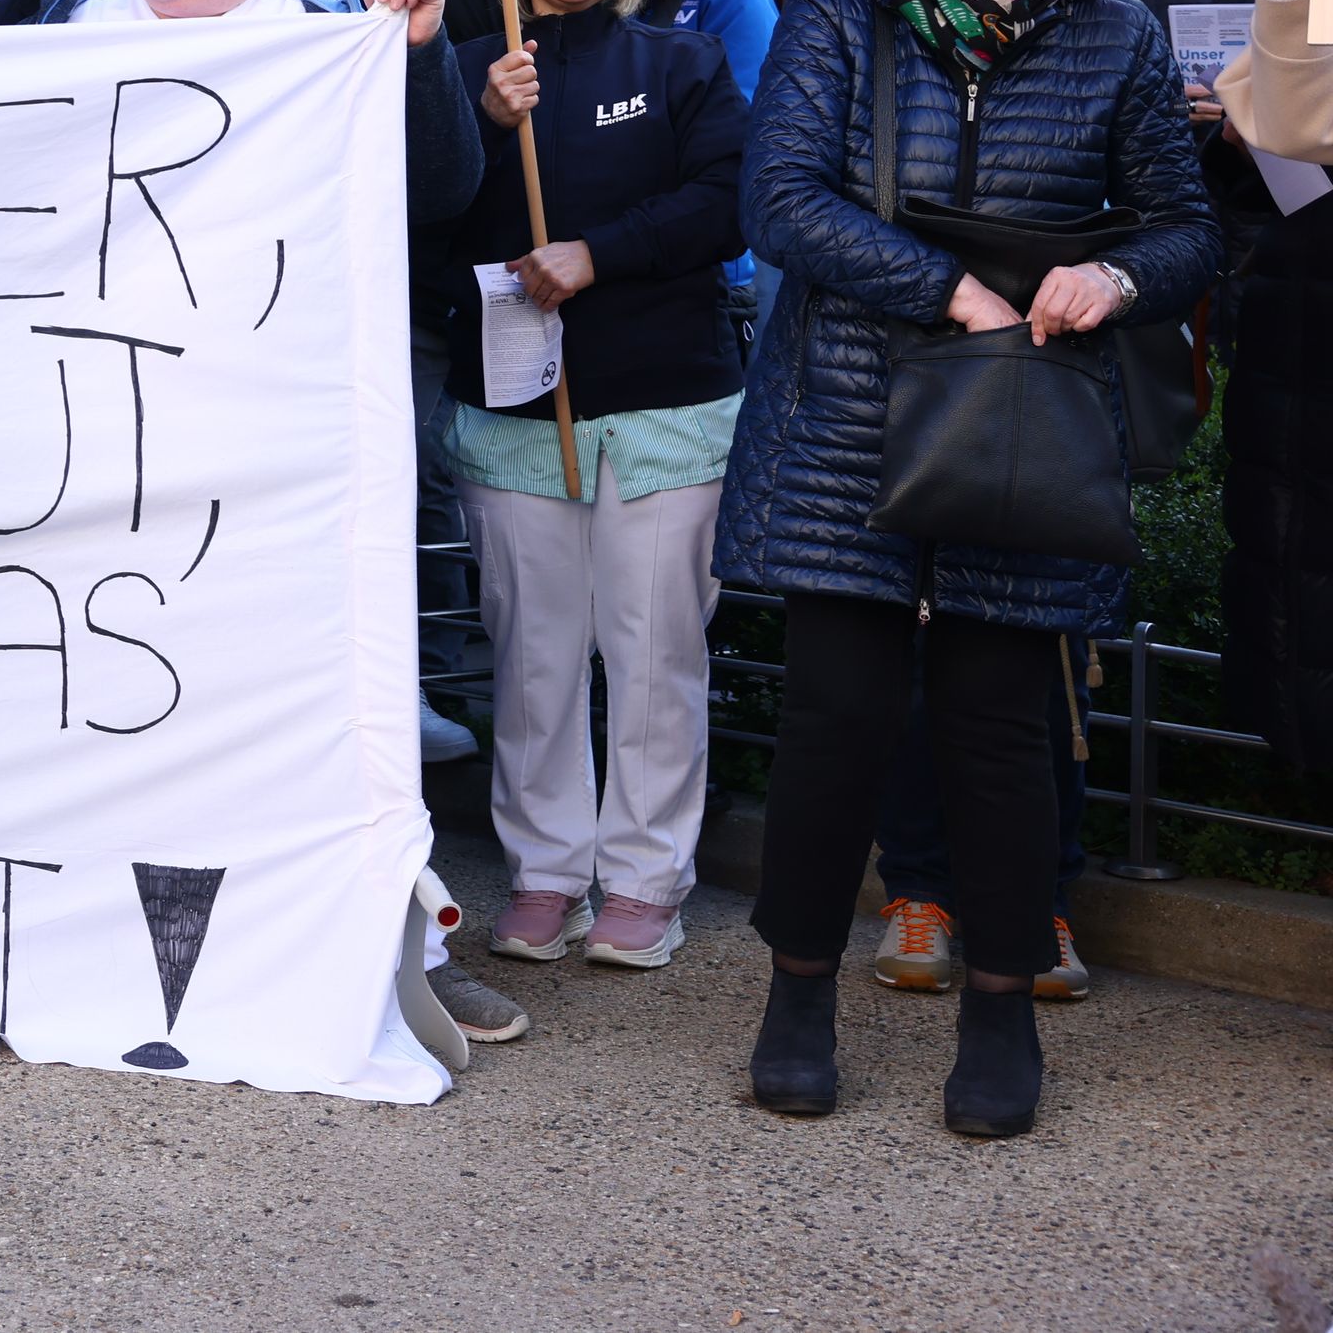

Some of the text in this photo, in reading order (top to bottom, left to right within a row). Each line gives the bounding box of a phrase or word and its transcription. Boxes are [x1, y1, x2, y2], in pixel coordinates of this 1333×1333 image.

[1178, 49, 1225, 60] Unser
[596, 93, 647, 119] LBK
[596, 107, 647, 127] Betriebsrat
